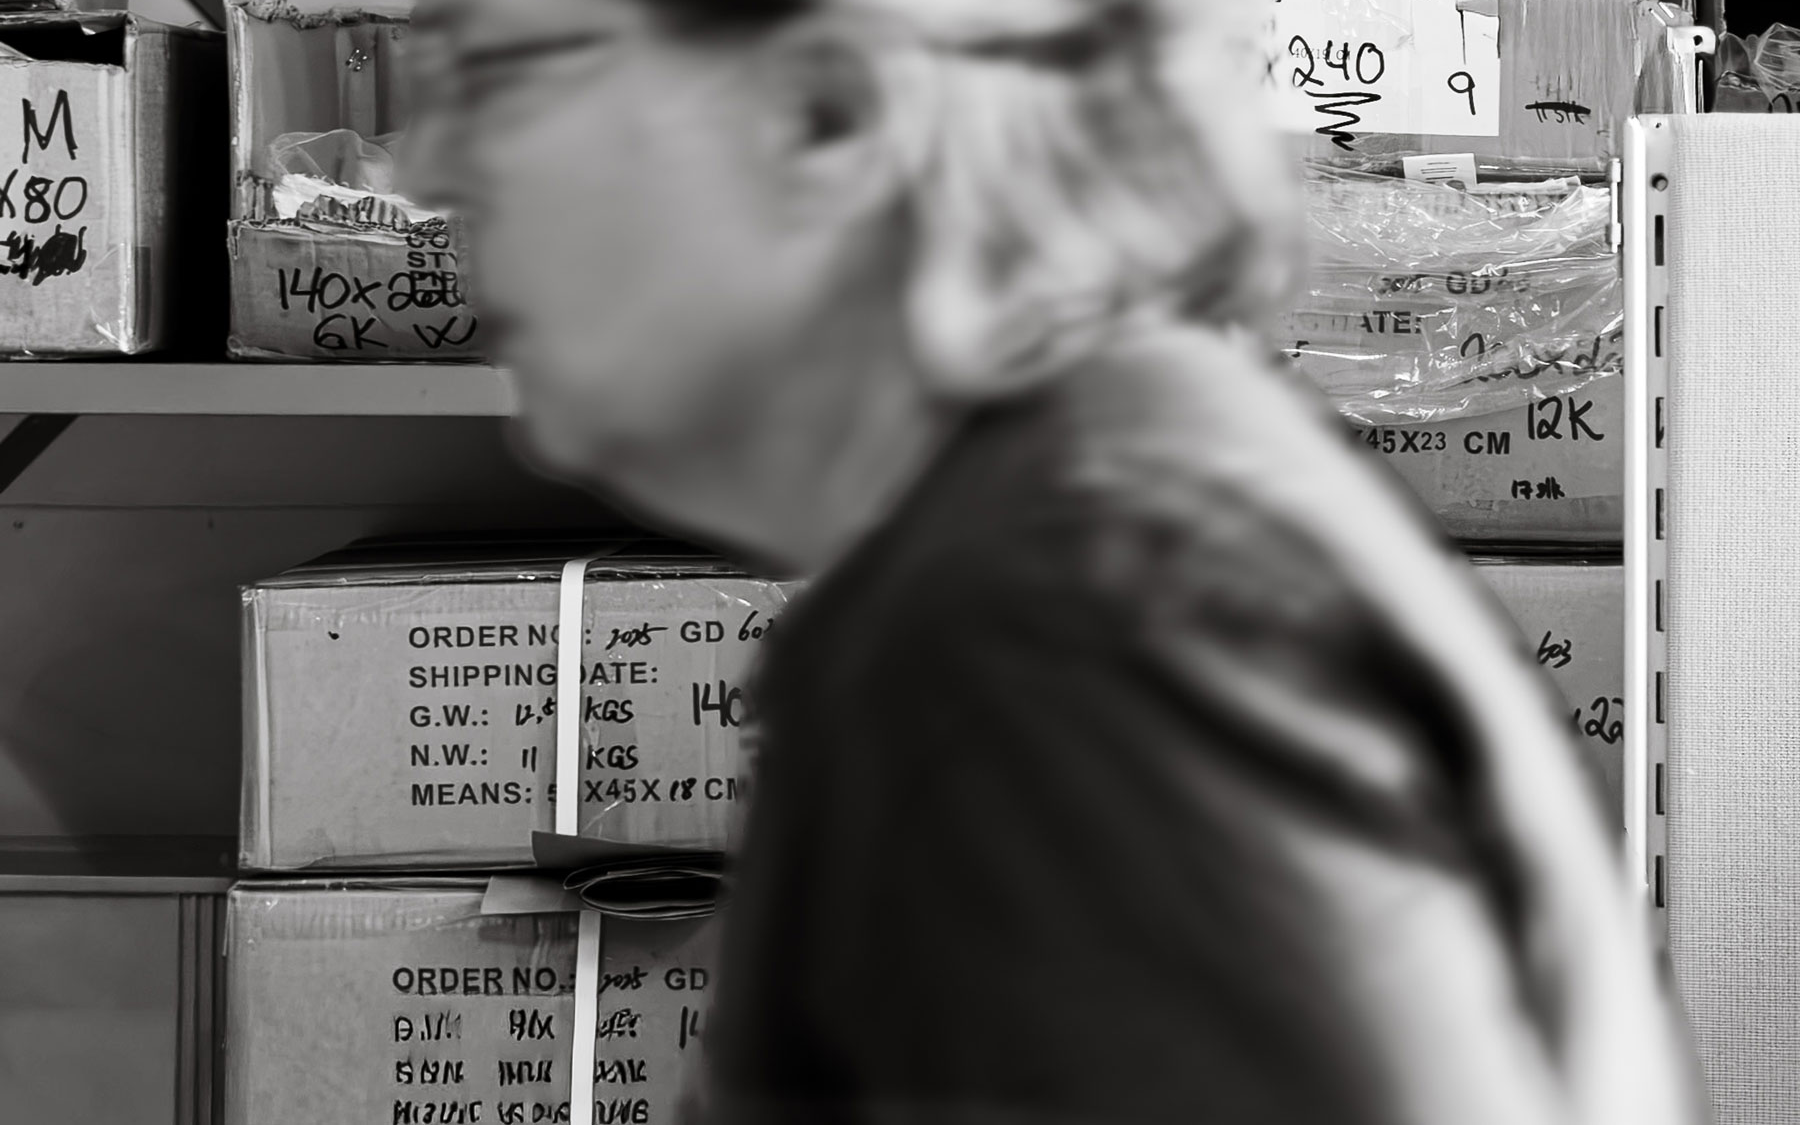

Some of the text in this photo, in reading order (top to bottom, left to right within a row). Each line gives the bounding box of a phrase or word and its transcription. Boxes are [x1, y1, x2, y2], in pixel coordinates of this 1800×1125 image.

[1288, 35, 1385, 87] 240
[1448, 71, 1476, 116] 9
[22, 89, 78, 164] M
[1528, 396, 1605, 441] 12K
[1464, 432, 1510, 454] CM
[409, 626, 519, 649] ORDER
[680, 621, 724, 643] GD
[1537, 631, 1572, 669] 603
[409, 664, 557, 688] SHIPPING
[409, 705, 488, 728] G.W.:
[410, 744, 487, 767] N.W.:
[411, 782, 532, 807] MEANS:
[393, 968, 503, 995] ORDER
[664, 968, 707, 990] GD
